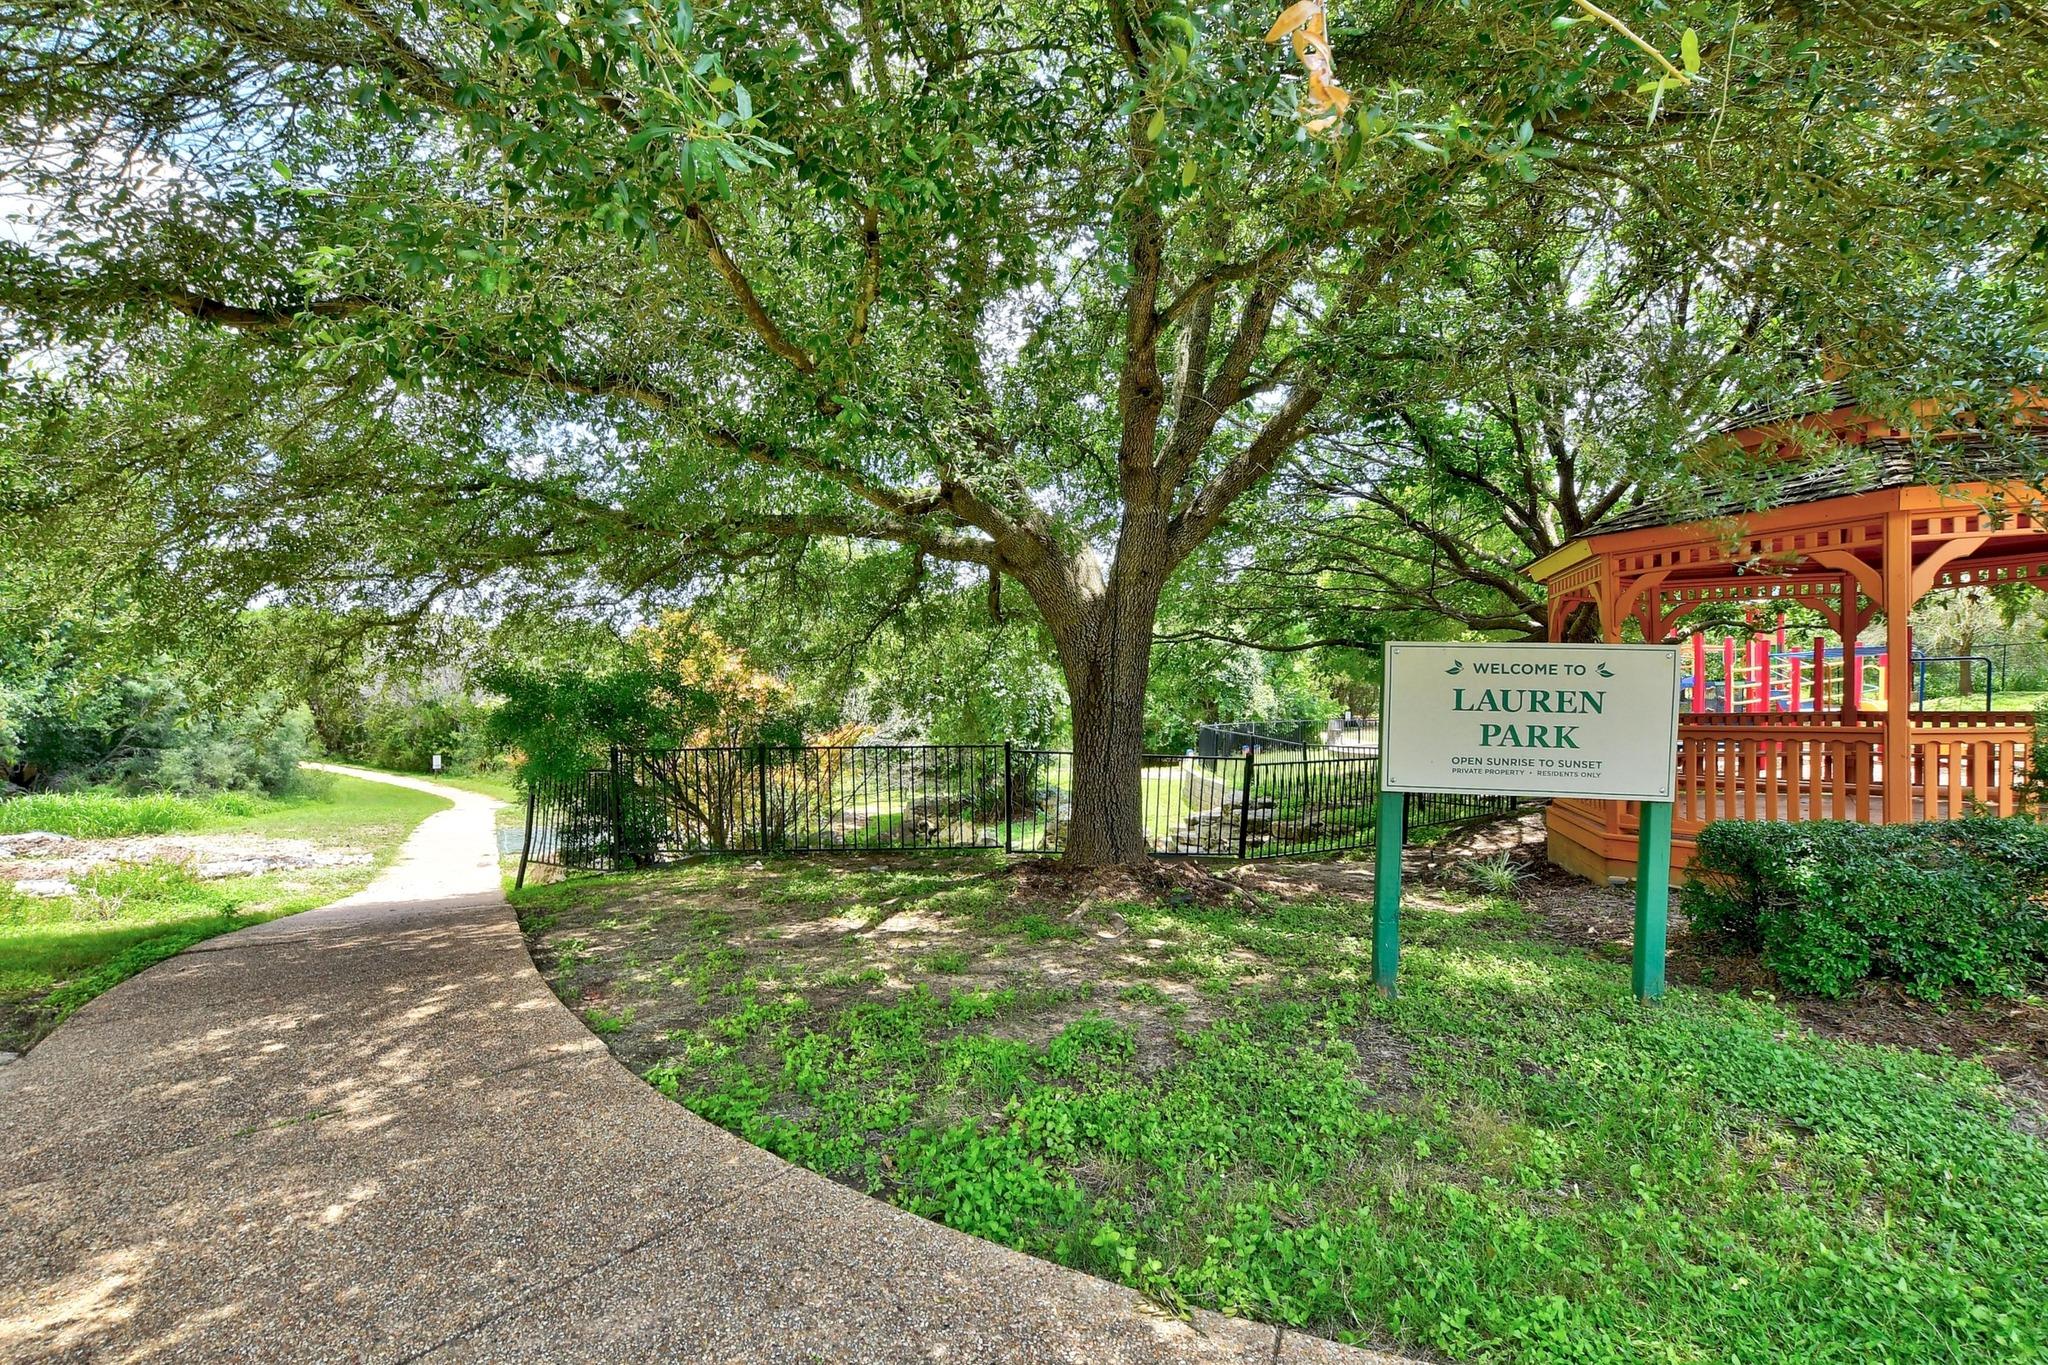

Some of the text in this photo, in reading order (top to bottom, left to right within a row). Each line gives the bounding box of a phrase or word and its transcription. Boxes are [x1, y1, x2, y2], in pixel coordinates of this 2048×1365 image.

[1473, 662, 1586, 676] WELCOME TO
[1452, 688, 1607, 714] LAUREN
[1479, 723, 1580, 749] PARK
[1451, 756, 1602, 769] OPEN SUNRISE TO SUNSET
[1537, 770, 1579, 778] RESIDENTS
[1580, 771, 1602, 779] ONLY
